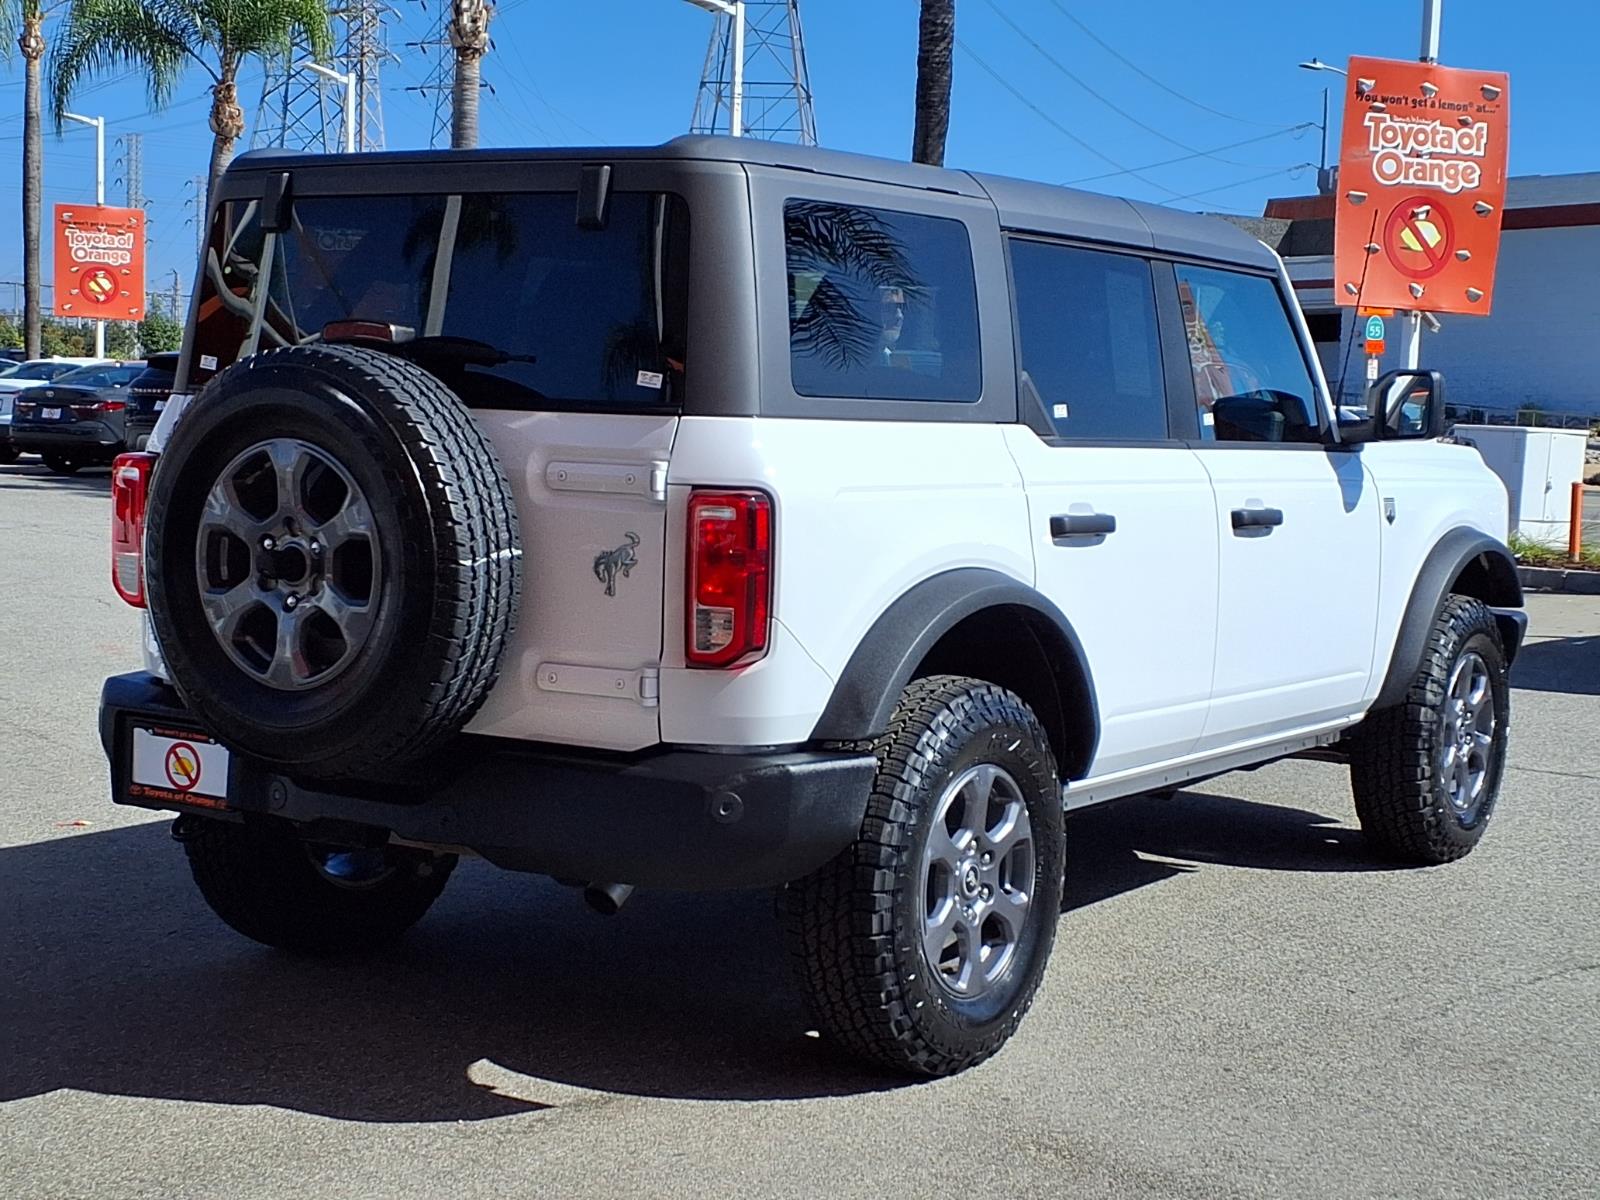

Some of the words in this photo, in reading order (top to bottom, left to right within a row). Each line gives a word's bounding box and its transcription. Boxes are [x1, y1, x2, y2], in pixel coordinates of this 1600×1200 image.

[1381, 95, 1409, 106] won't
[1411, 97, 1428, 109] get
[1430, 99, 1436, 108] a
[1365, 113, 1456, 153] Toyota
[1457, 122, 1488, 156] of
[1373, 149, 1481, 193] Orange
[65, 229, 115, 247] Toyota
[116, 233, 134, 248] of
[71, 246, 131, 265] Orange
[1370, 326, 1381, 337] 55
[143, 787, 173, 798] Toyota
[174, 791, 184, 800] of
